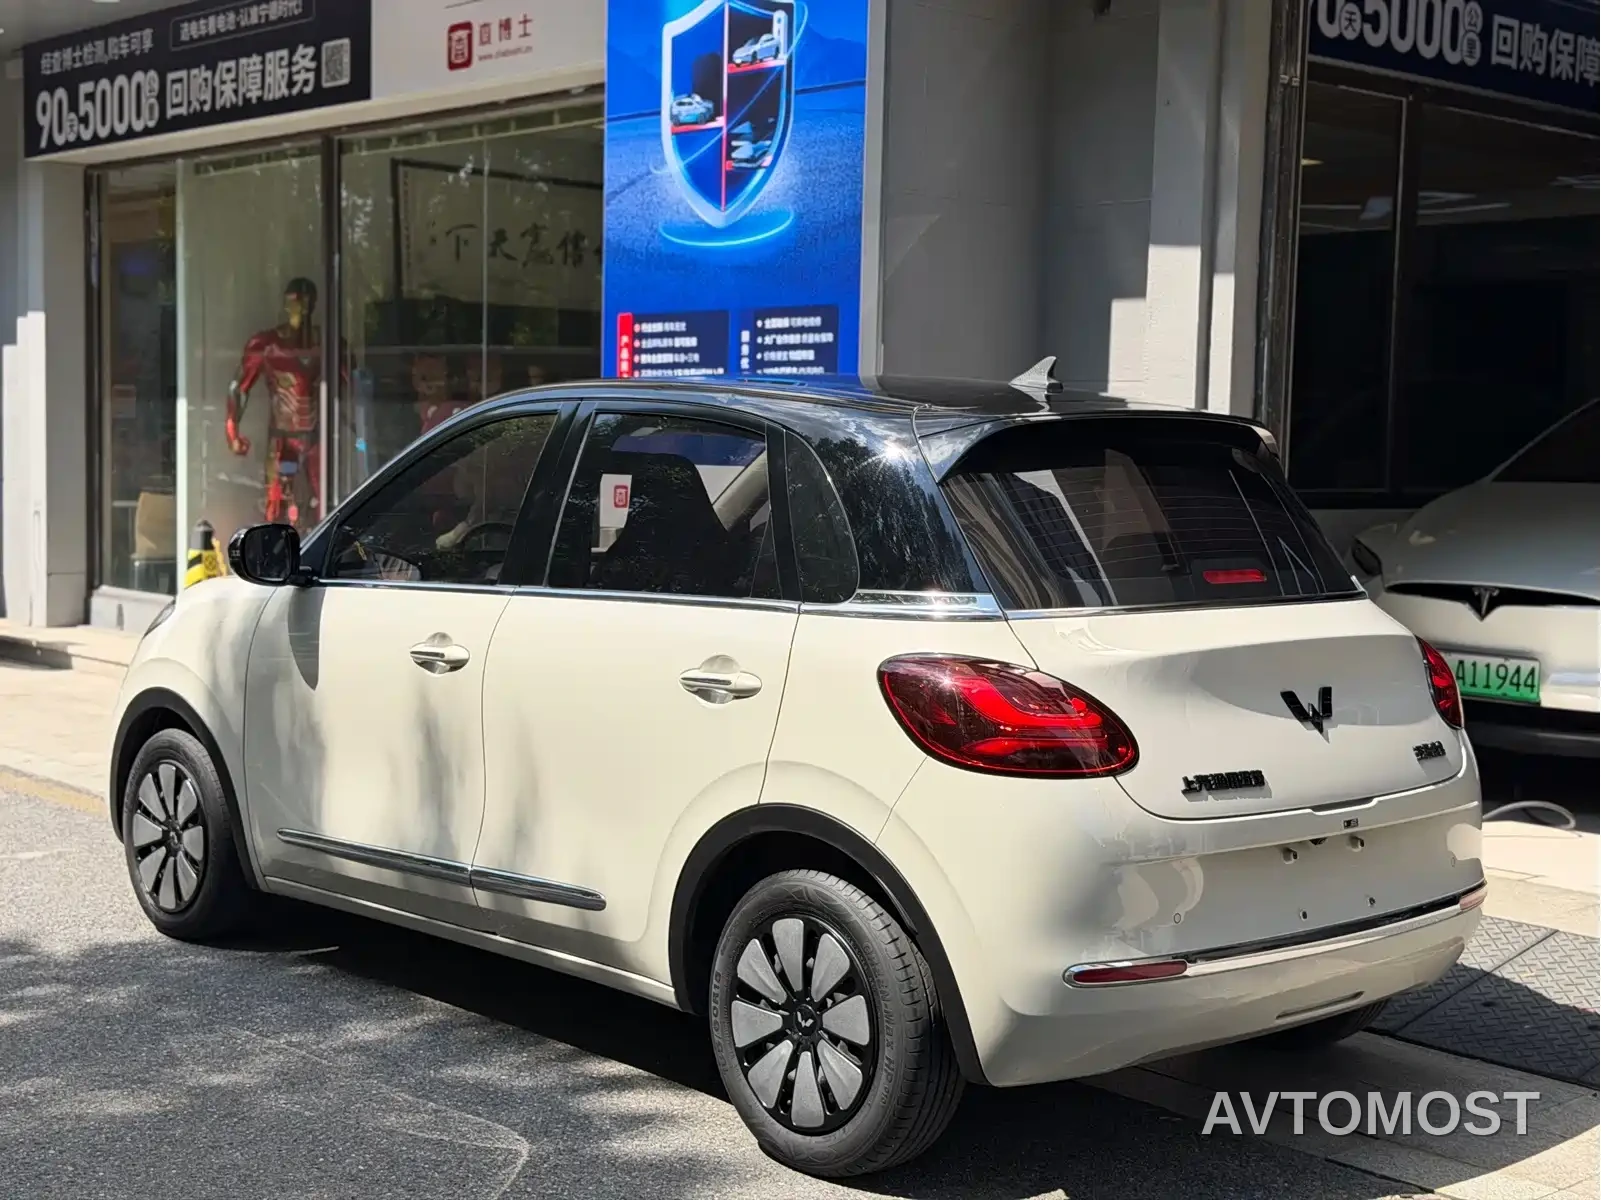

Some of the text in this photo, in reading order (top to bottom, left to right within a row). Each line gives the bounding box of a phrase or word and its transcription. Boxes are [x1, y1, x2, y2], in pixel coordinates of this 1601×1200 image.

[165, 44, 318, 121] 回购保障服务
[1455, 659, 1537, 694] A11944
